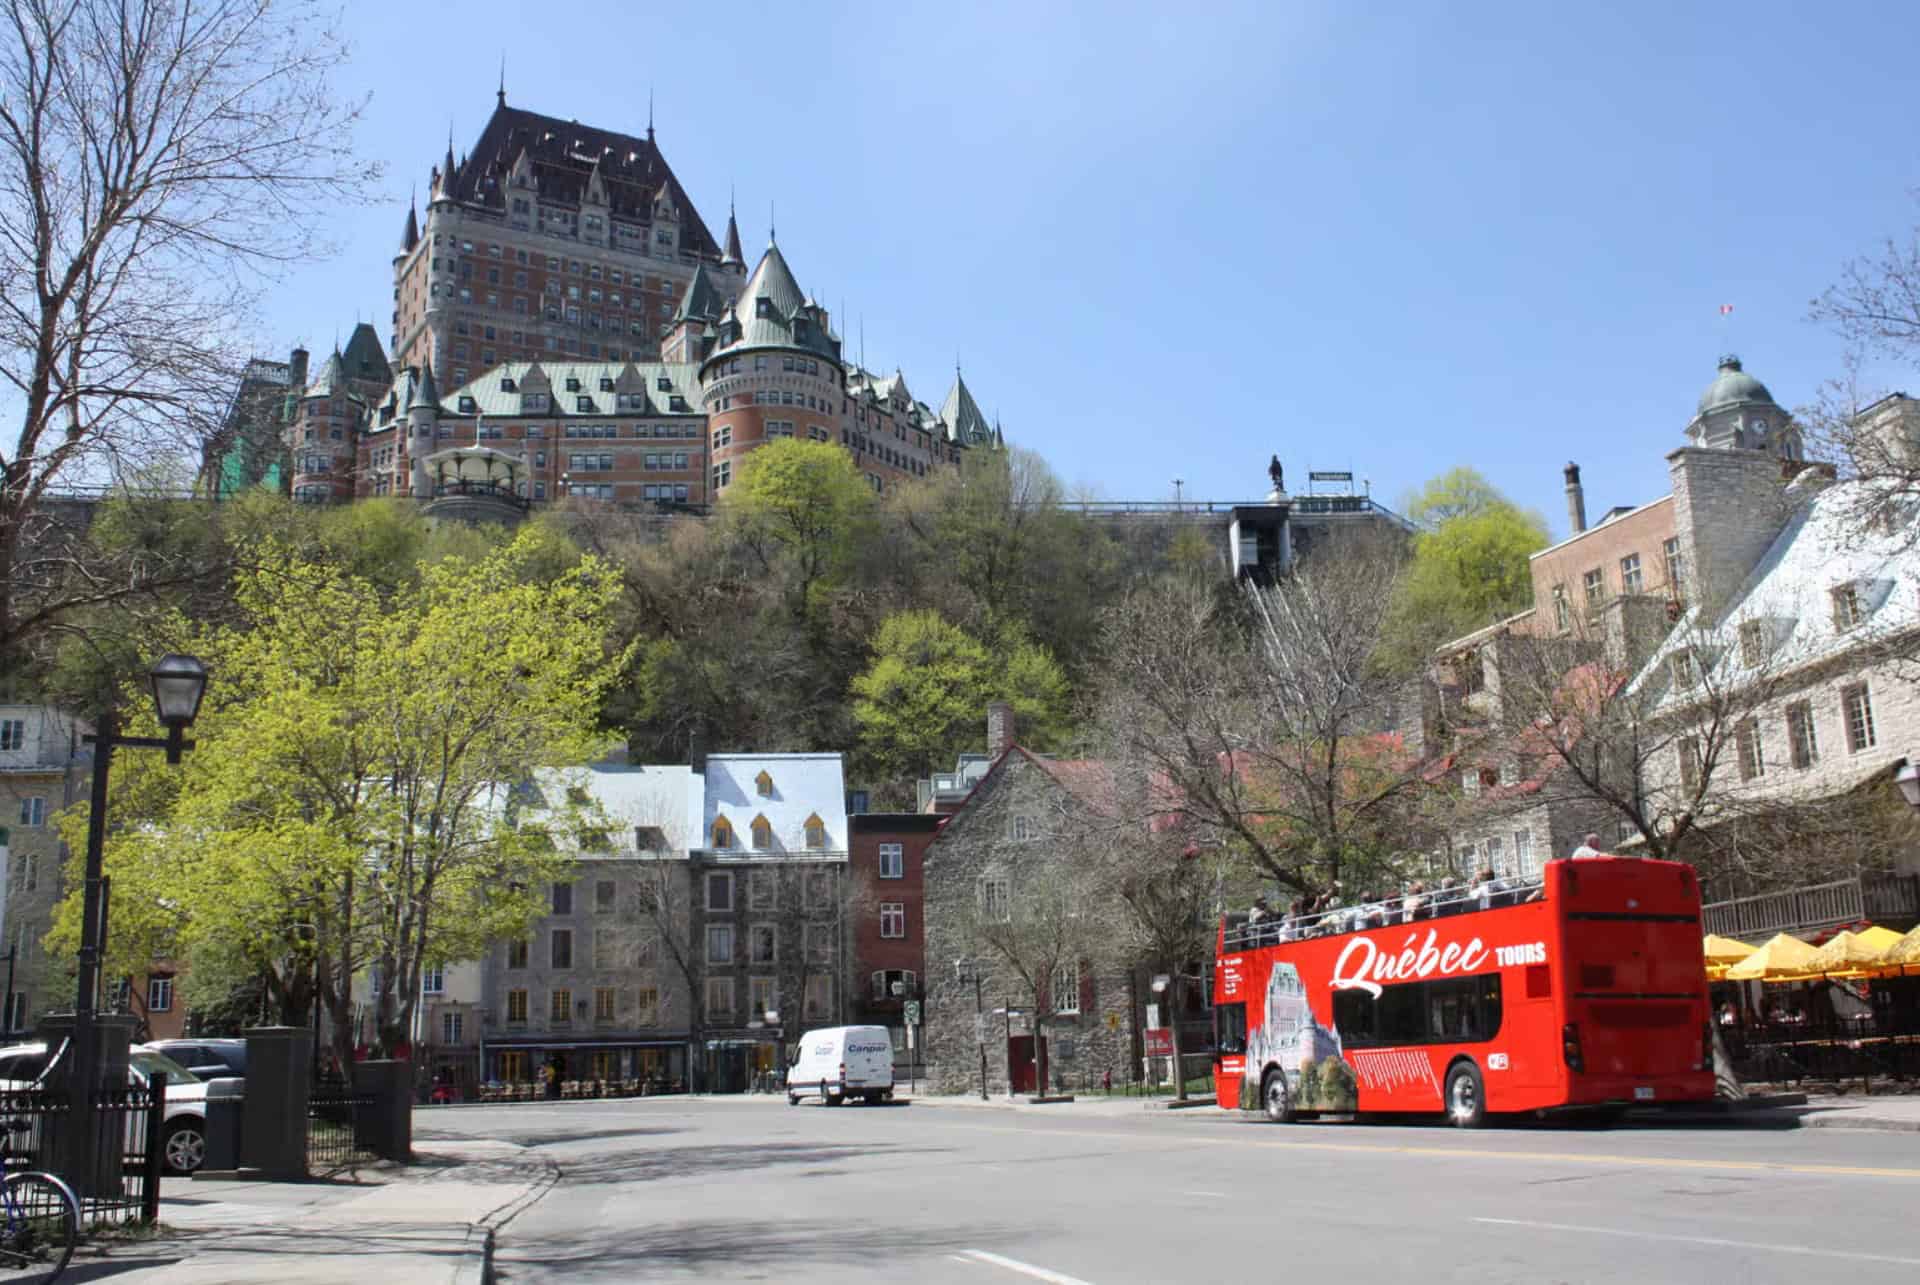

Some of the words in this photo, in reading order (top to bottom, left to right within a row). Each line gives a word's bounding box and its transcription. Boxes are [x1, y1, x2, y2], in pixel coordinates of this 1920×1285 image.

[1328, 928, 1490, 1000] Québec
[1495, 941, 1546, 967] TOURS
[847, 1044, 888, 1053] Canpar
